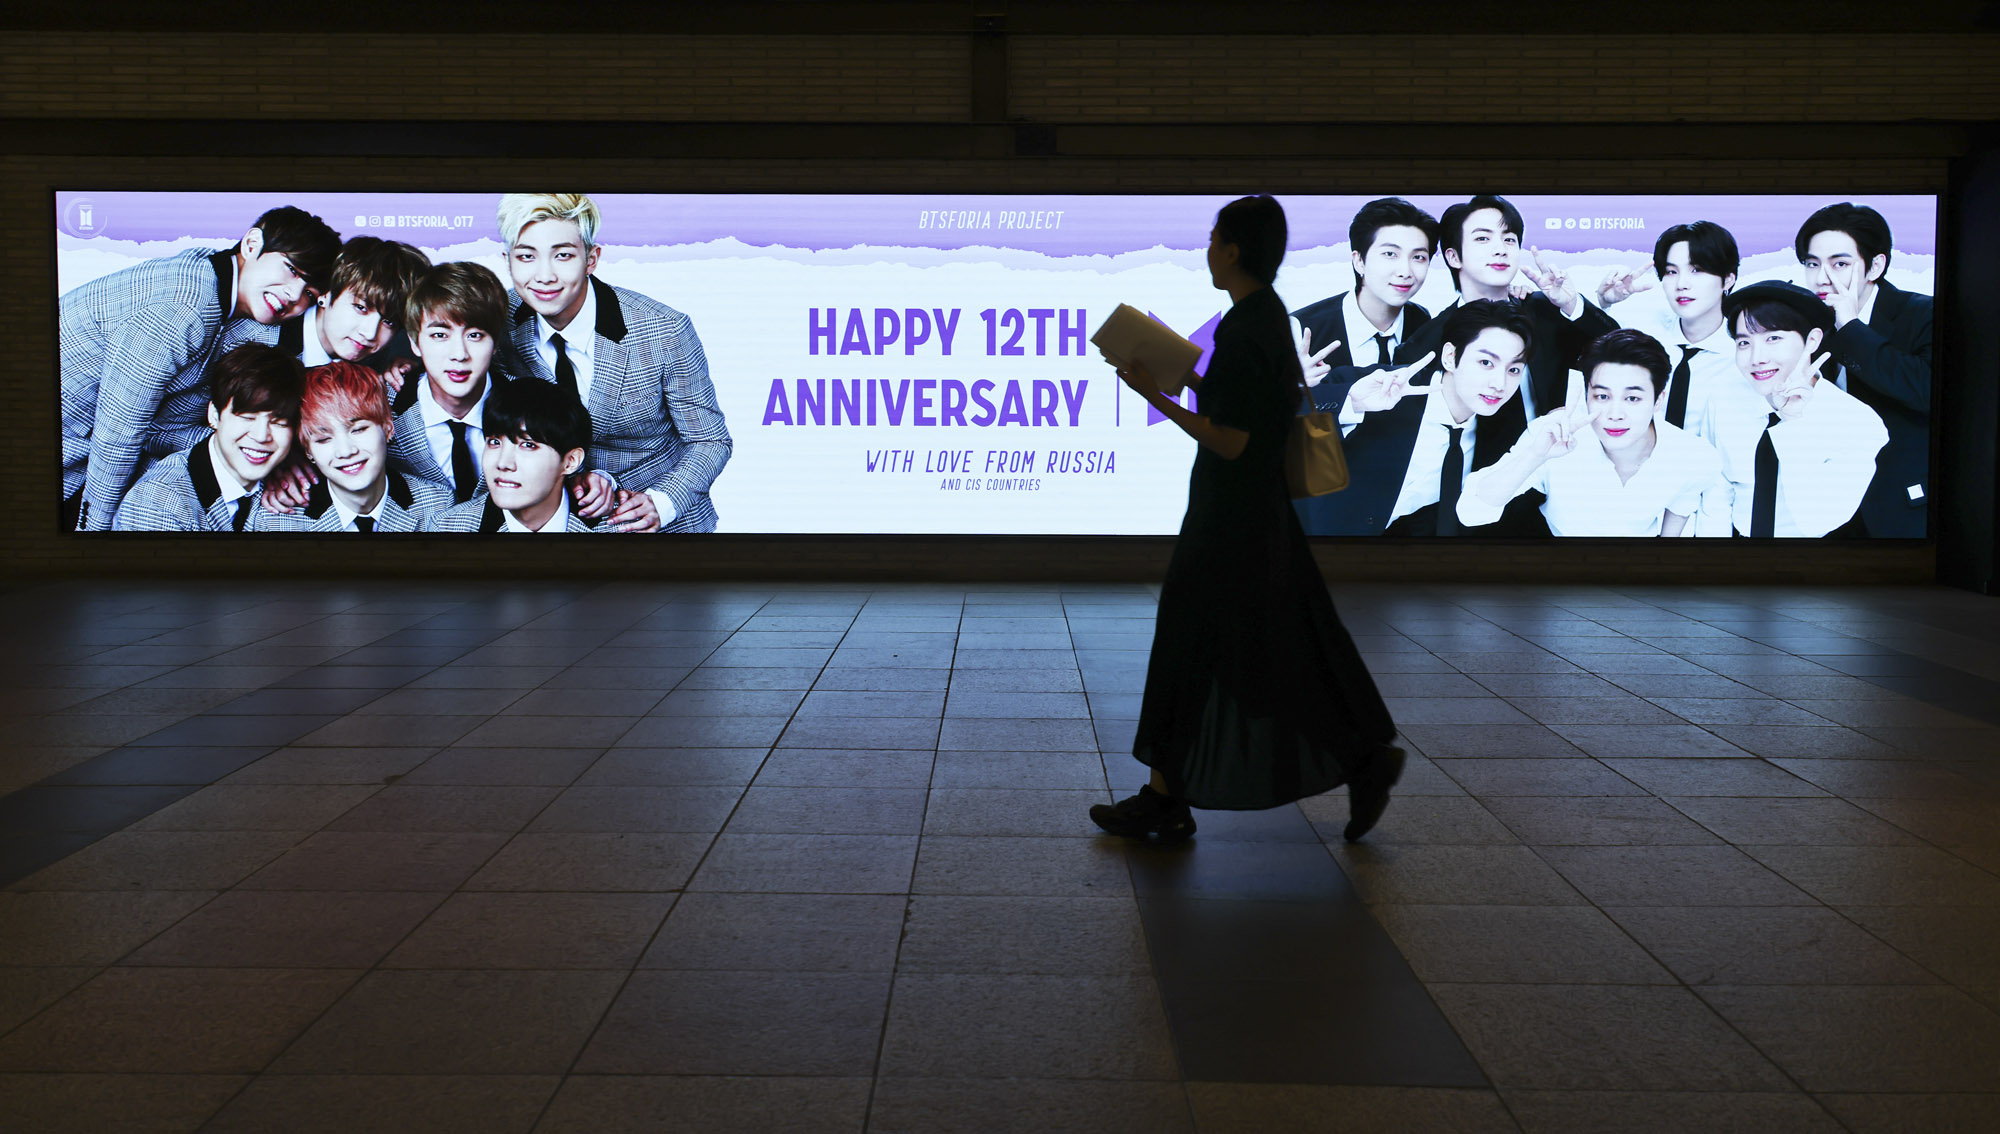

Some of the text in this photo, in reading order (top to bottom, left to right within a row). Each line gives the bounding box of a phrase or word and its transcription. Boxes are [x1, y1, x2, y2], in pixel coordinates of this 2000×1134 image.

[919, 210, 1064, 230] BTSFORIA PROJECT
[1593, 217, 1645, 230] BTSFORIA
[809, 307, 1087, 357] HAPPY 12TH
[761, 378, 1089, 427] ANNIVERSARY
[866, 449, 1116, 474] WITH LOVE FROM RUSSIA
[940, 478, 1041, 491] AND CIS COUNTRIES
